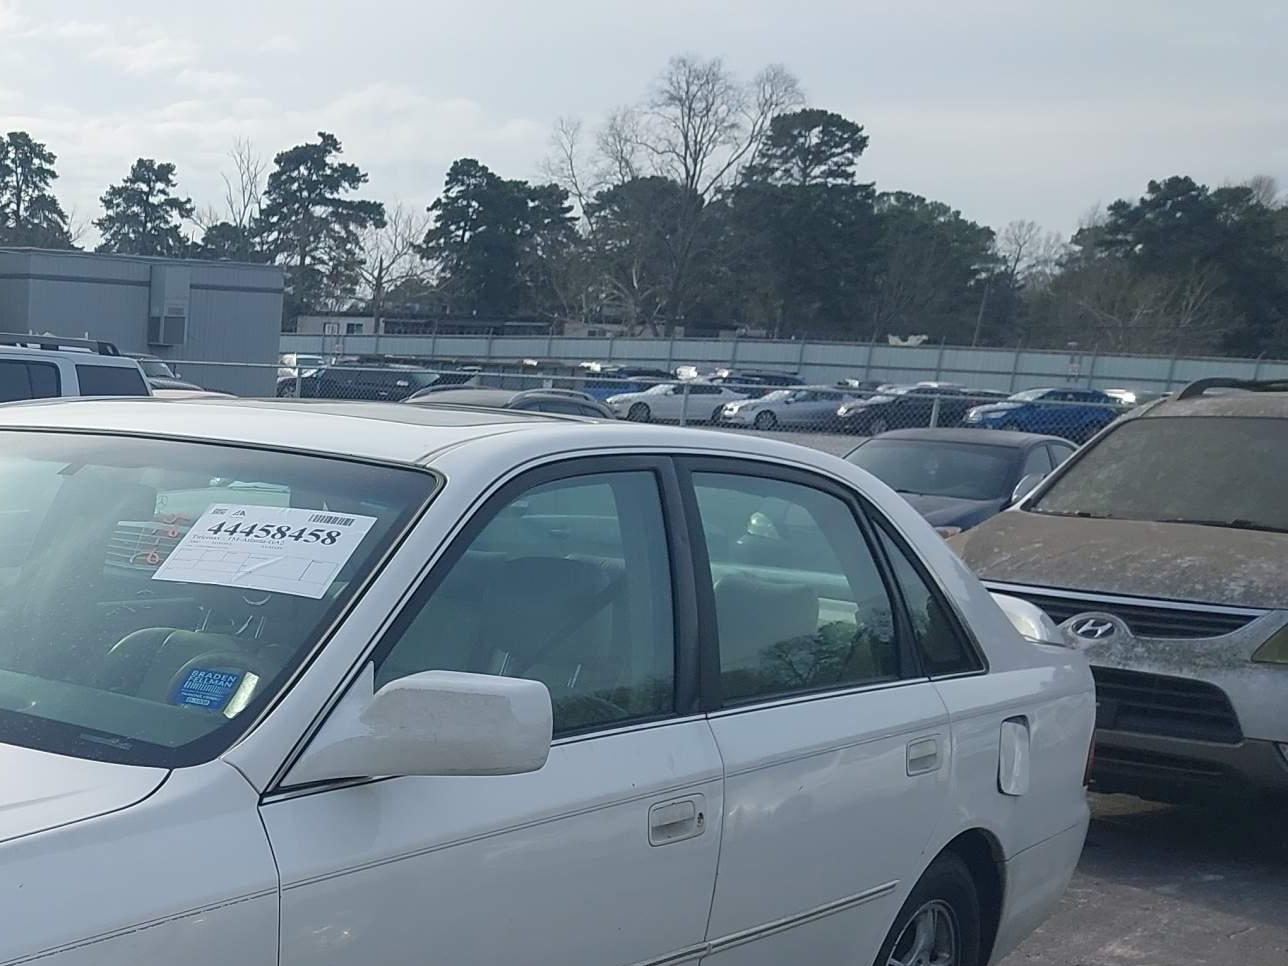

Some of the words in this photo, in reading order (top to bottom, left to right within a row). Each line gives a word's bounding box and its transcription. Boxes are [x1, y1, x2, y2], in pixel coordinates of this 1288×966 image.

[207, 520, 342, 546] 44458458
[188, 675, 233, 688] FELLMAN
[191, 670, 237, 683] BRADEN
